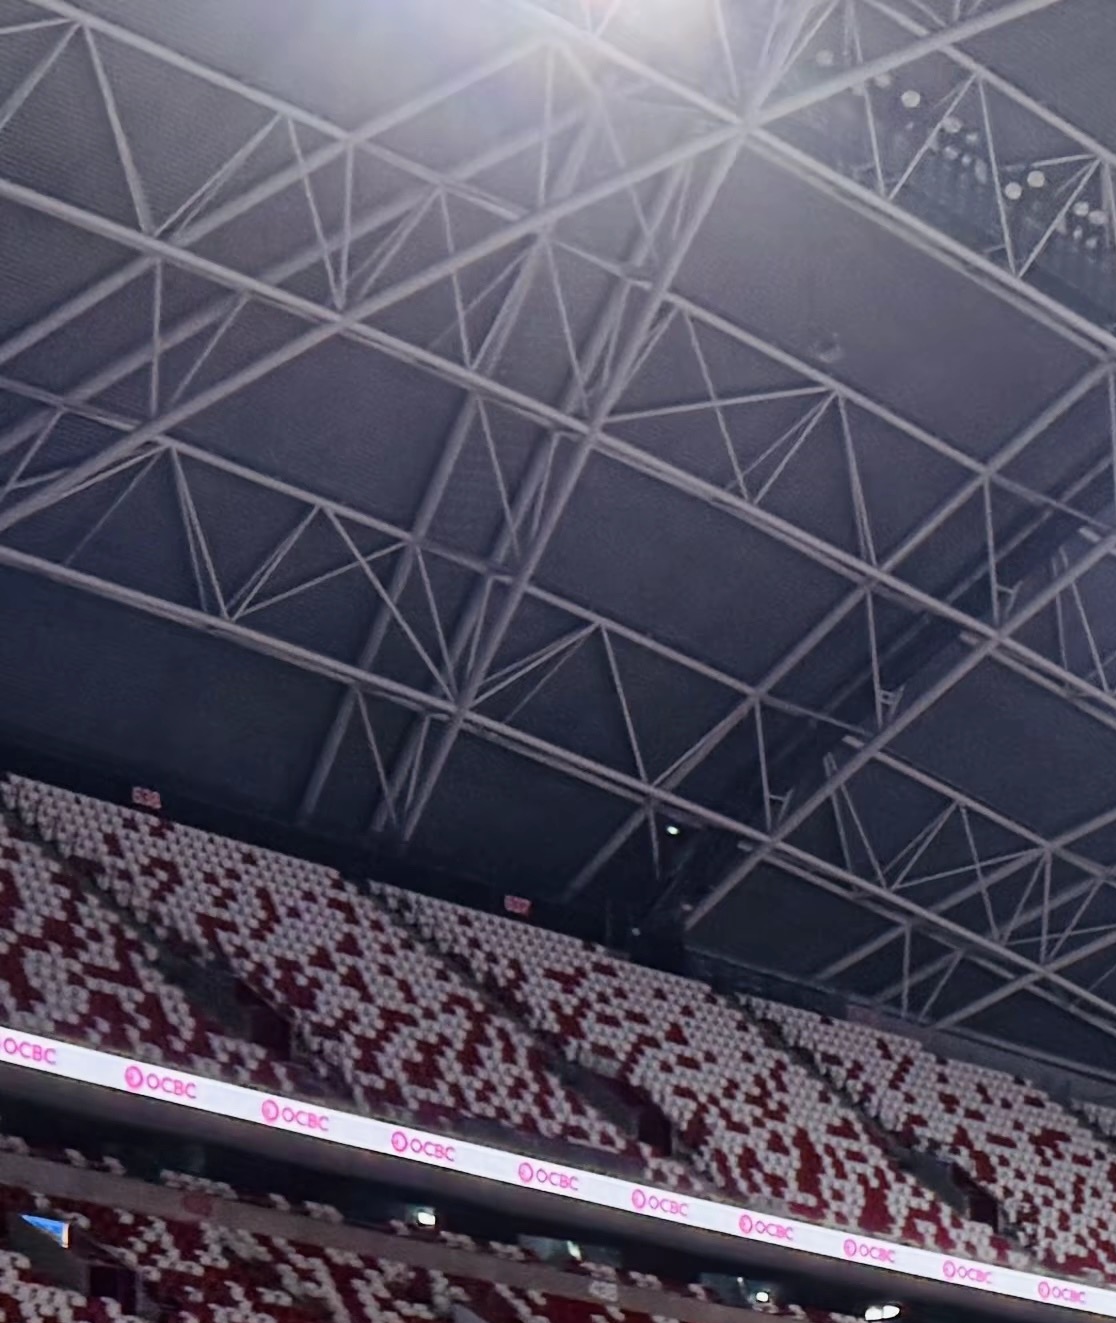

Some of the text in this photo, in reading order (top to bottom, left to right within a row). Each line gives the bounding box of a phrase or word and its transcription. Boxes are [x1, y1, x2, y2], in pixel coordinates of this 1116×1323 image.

[3, 1037, 57, 1065] OCBC
[147, 1073, 197, 1100] OCBC
[281, 1107, 329, 1132] OCBC
[410, 1138, 456, 1163] OCBC
[536, 1168, 580, 1192] OCBC
[648, 1194, 689, 1217] OCBC
[755, 1219, 794, 1241] OCBC
